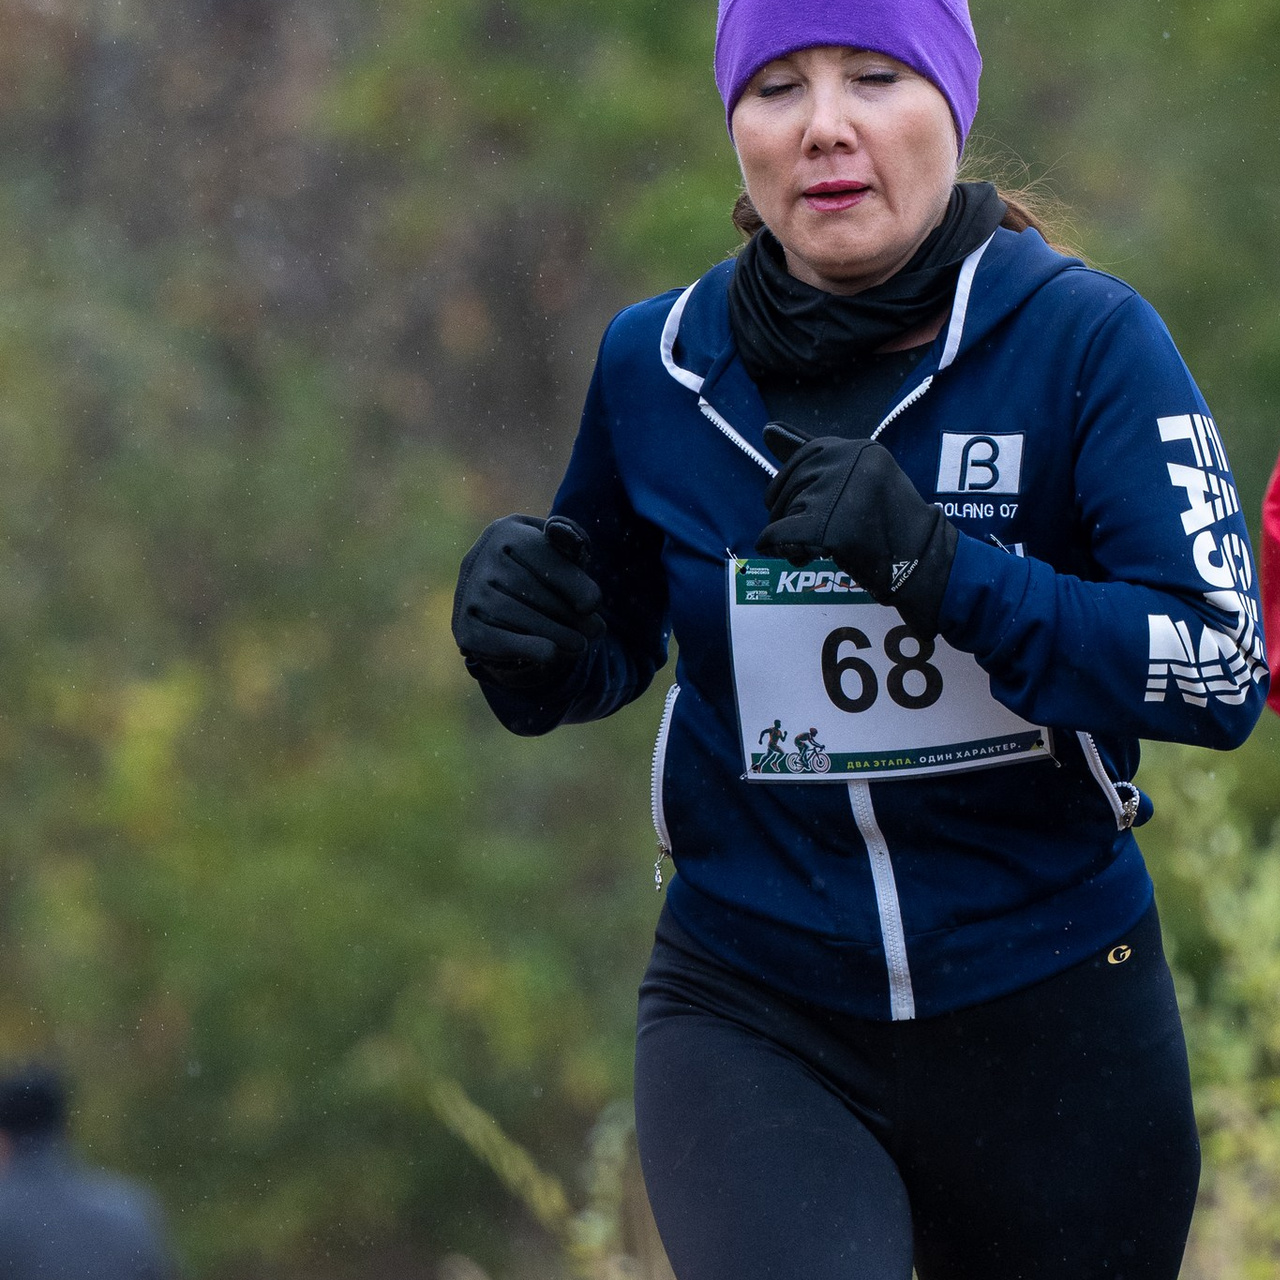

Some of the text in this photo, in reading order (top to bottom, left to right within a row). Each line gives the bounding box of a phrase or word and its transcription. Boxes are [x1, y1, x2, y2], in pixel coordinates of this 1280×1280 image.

[933, 503, 1018, 519] OLANG 07
[890, 559, 919, 592] ProfiCamp
[821, 624, 944, 714] 68
[846, 742, 1021, 770] ДВА ЭТАПА. ОДИН ХАРАКТЕР.
